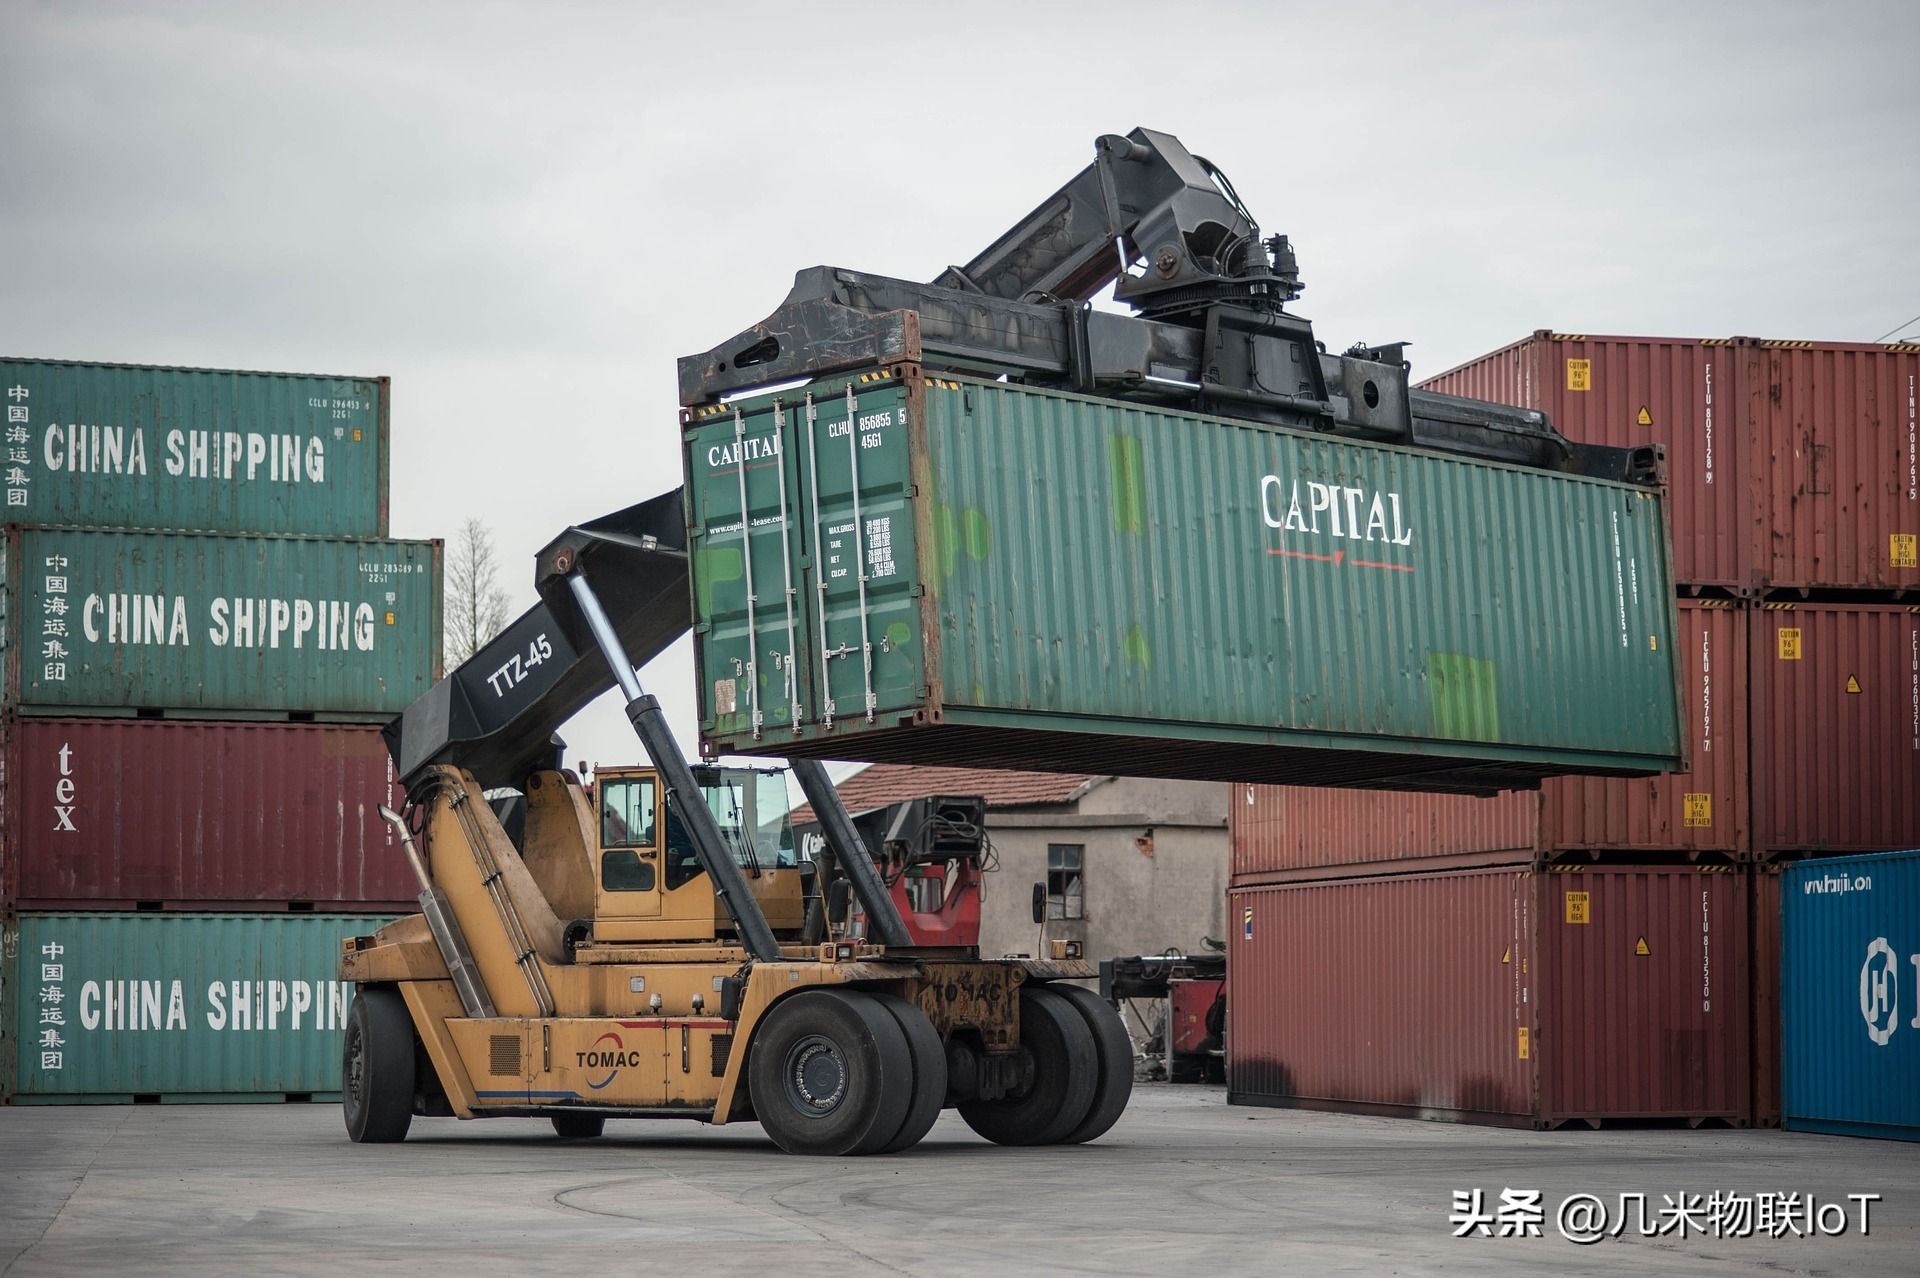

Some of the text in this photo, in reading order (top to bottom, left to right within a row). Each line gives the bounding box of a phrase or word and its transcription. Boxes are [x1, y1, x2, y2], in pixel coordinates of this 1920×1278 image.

[5, 384, 31, 507] 中国海运集团
[44, 423, 325, 483] CHINA SHIPPING
[828, 420, 850, 438] CLHU
[859, 411, 892, 432] 856855
[861, 432, 882, 449] 45G1
[1706, 471, 1713, 484] 9
[1909, 488, 1916, 500] 5
[1260, 474, 1412, 546] CAPITAL
[42, 553, 70, 681] 中国海运集团
[83, 592, 375, 651] CHINA SHIPPING
[486, 633, 553, 698] TTZ-45
[53, 742, 77, 831] tex
[39, 941, 66, 1071] 中国海运集团
[79, 980, 356, 1031] CHINA SHIPPIN
[576, 1051, 640, 1068] TOMAC
